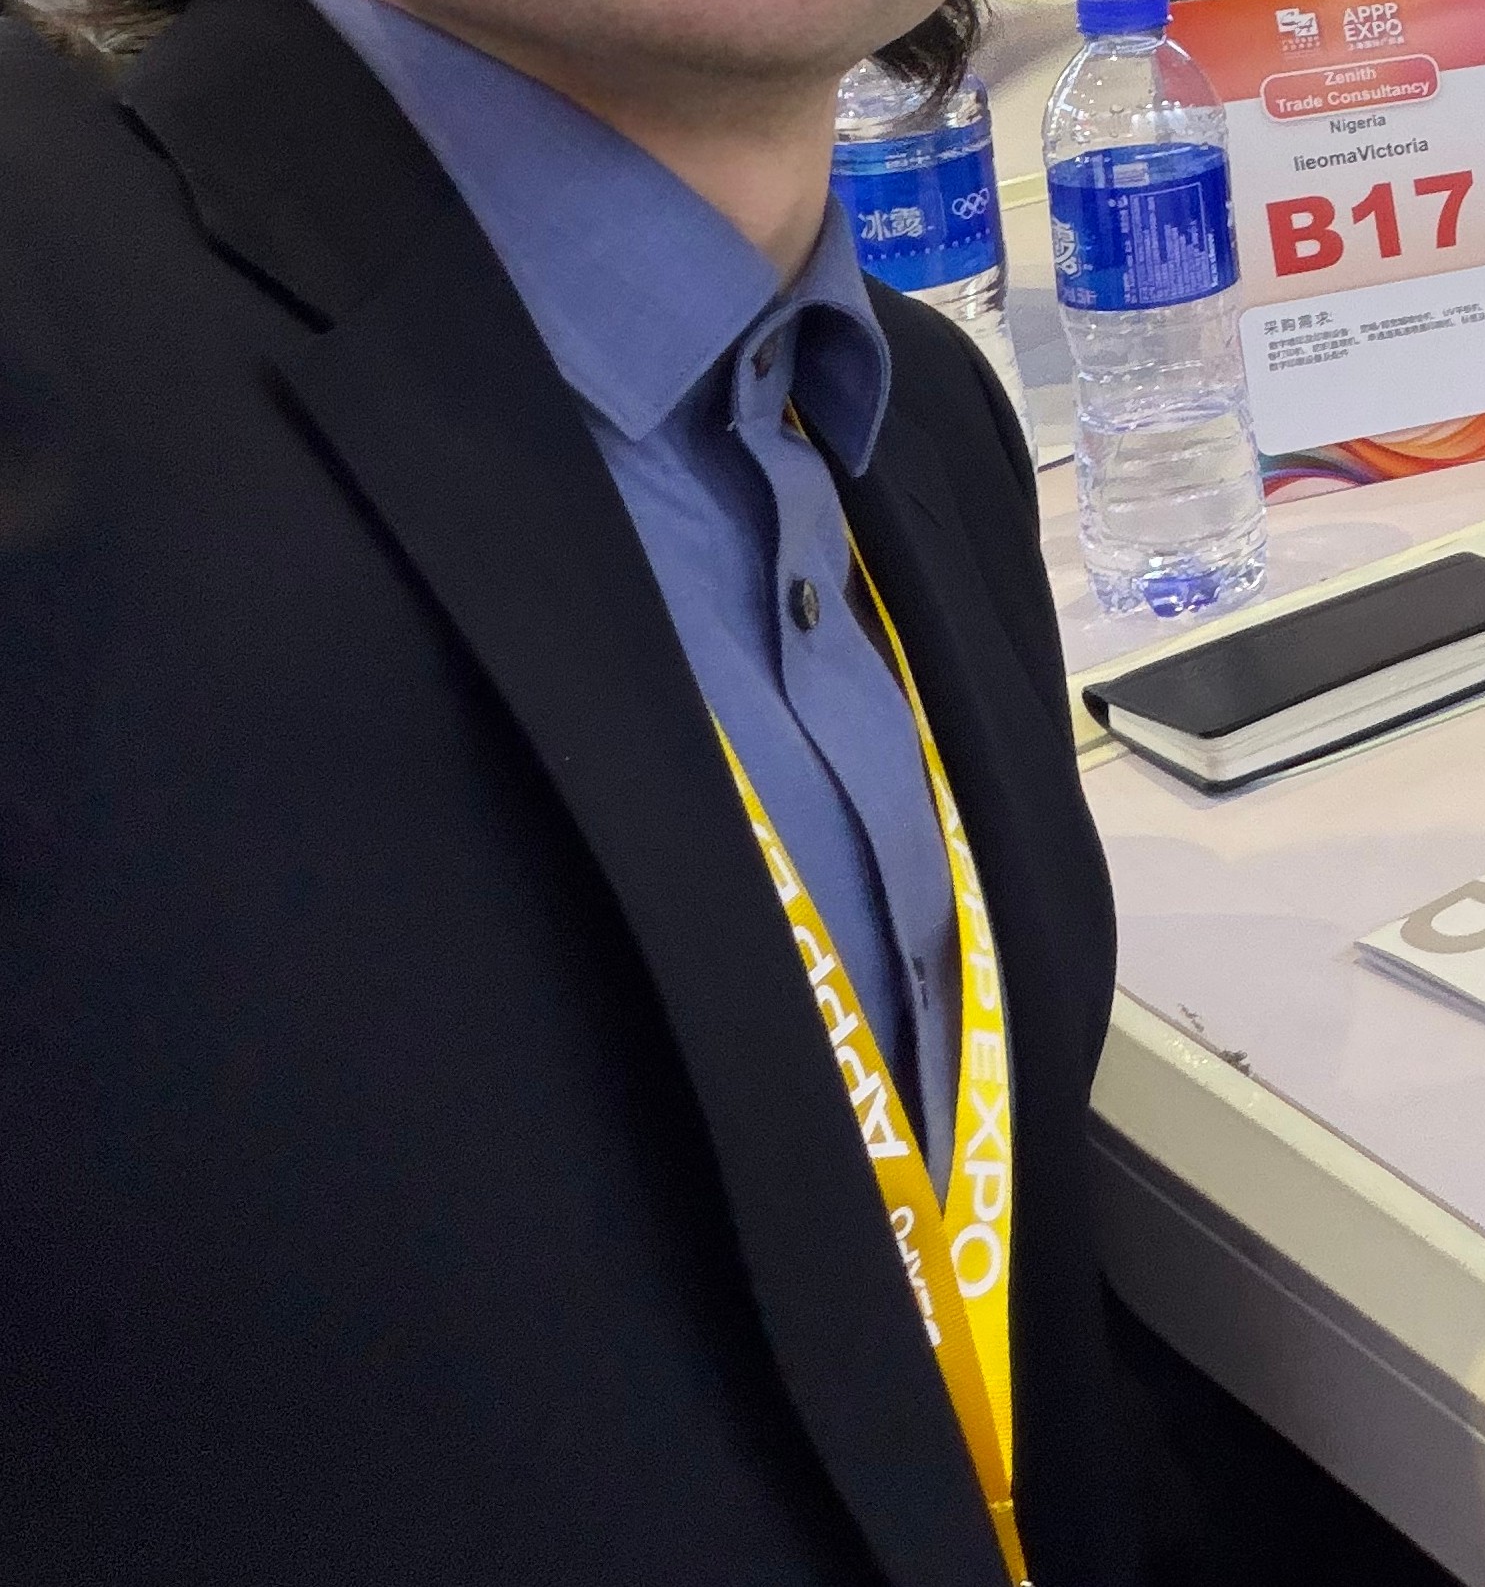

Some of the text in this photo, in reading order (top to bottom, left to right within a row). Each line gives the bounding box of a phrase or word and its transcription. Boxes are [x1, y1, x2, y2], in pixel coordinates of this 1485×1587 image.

[1343, 2, 1399, 25] APPP
[1344, 18, 1403, 42] EXPO
[1323, 67, 1377, 86] Zenith
[1276, 81, 1430, 113] Trade Consultancy
[1330, 114, 1387, 134] Nigeria
[1265, 170, 1474, 278] B17
[950, 1028, 1009, 1299] EXPO
